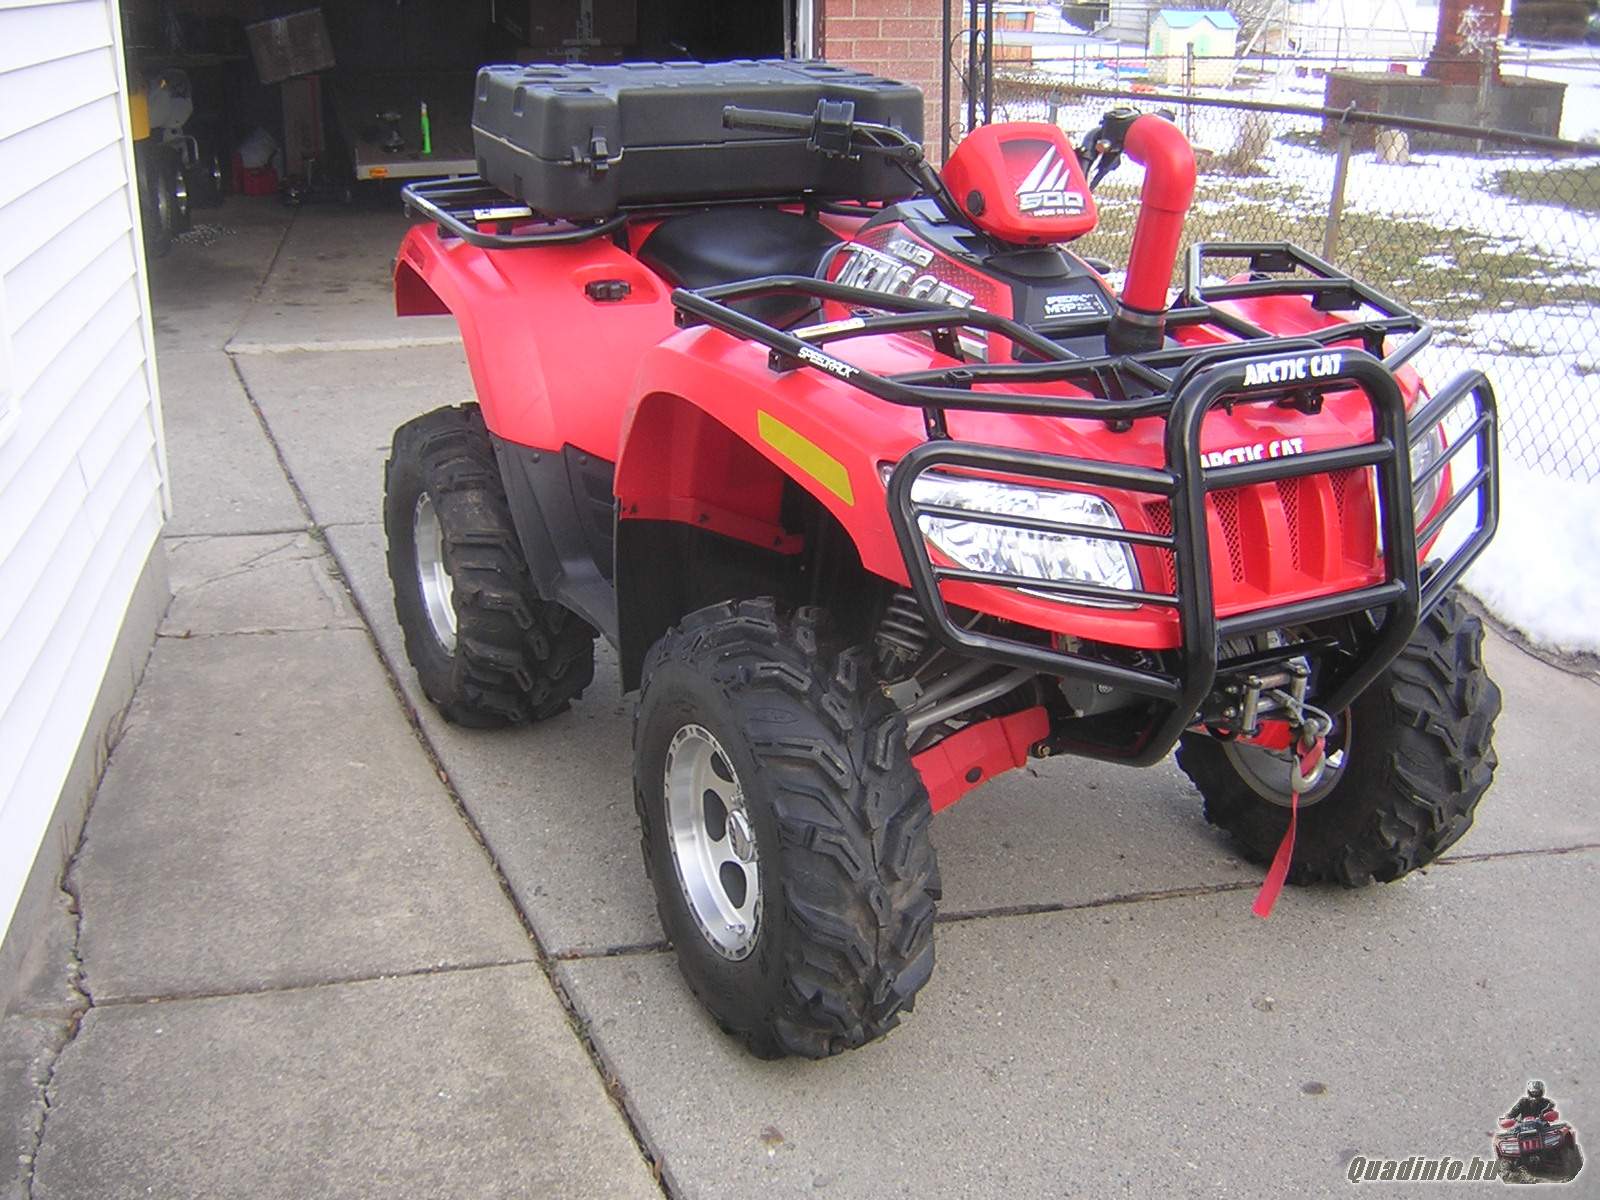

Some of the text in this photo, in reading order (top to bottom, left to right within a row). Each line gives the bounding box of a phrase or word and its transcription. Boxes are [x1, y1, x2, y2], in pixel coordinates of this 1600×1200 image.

[1018, 191, 1084, 211] 500
[834, 242, 975, 309] ARCTIC CAT
[1243, 353, 1342, 386] ARCTIC CAT
[1269, 437, 1304, 458] CAT
